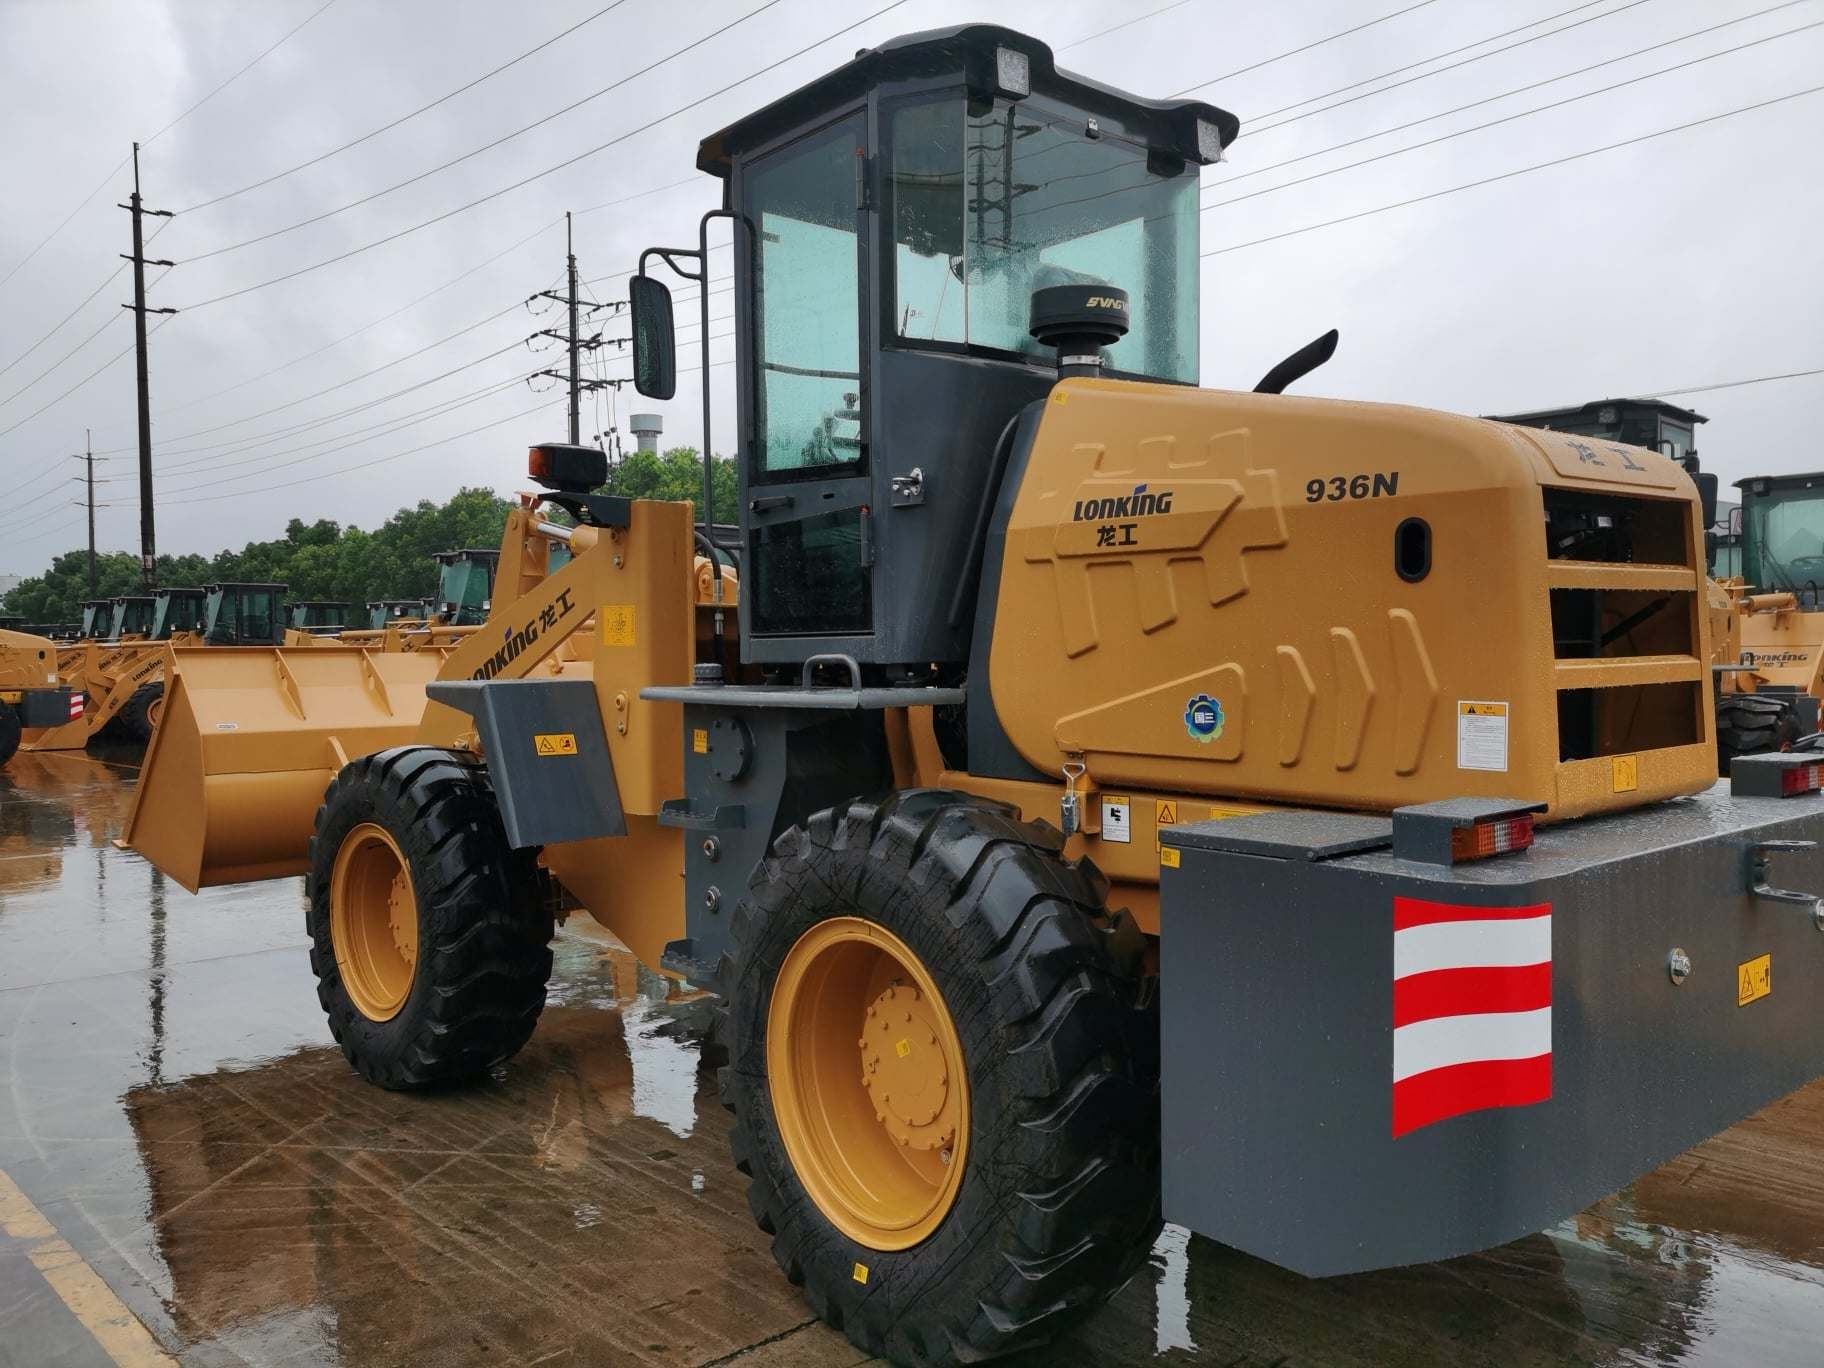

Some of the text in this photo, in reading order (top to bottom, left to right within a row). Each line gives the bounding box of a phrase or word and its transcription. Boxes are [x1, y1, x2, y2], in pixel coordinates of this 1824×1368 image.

[1073, 484, 1173, 521] LONKING
[1305, 472, 1399, 502] 936N
[1097, 524, 1138, 547] 龙工
[467, 620, 538, 680] ONKING
[538, 587, 575, 634] 龙工
